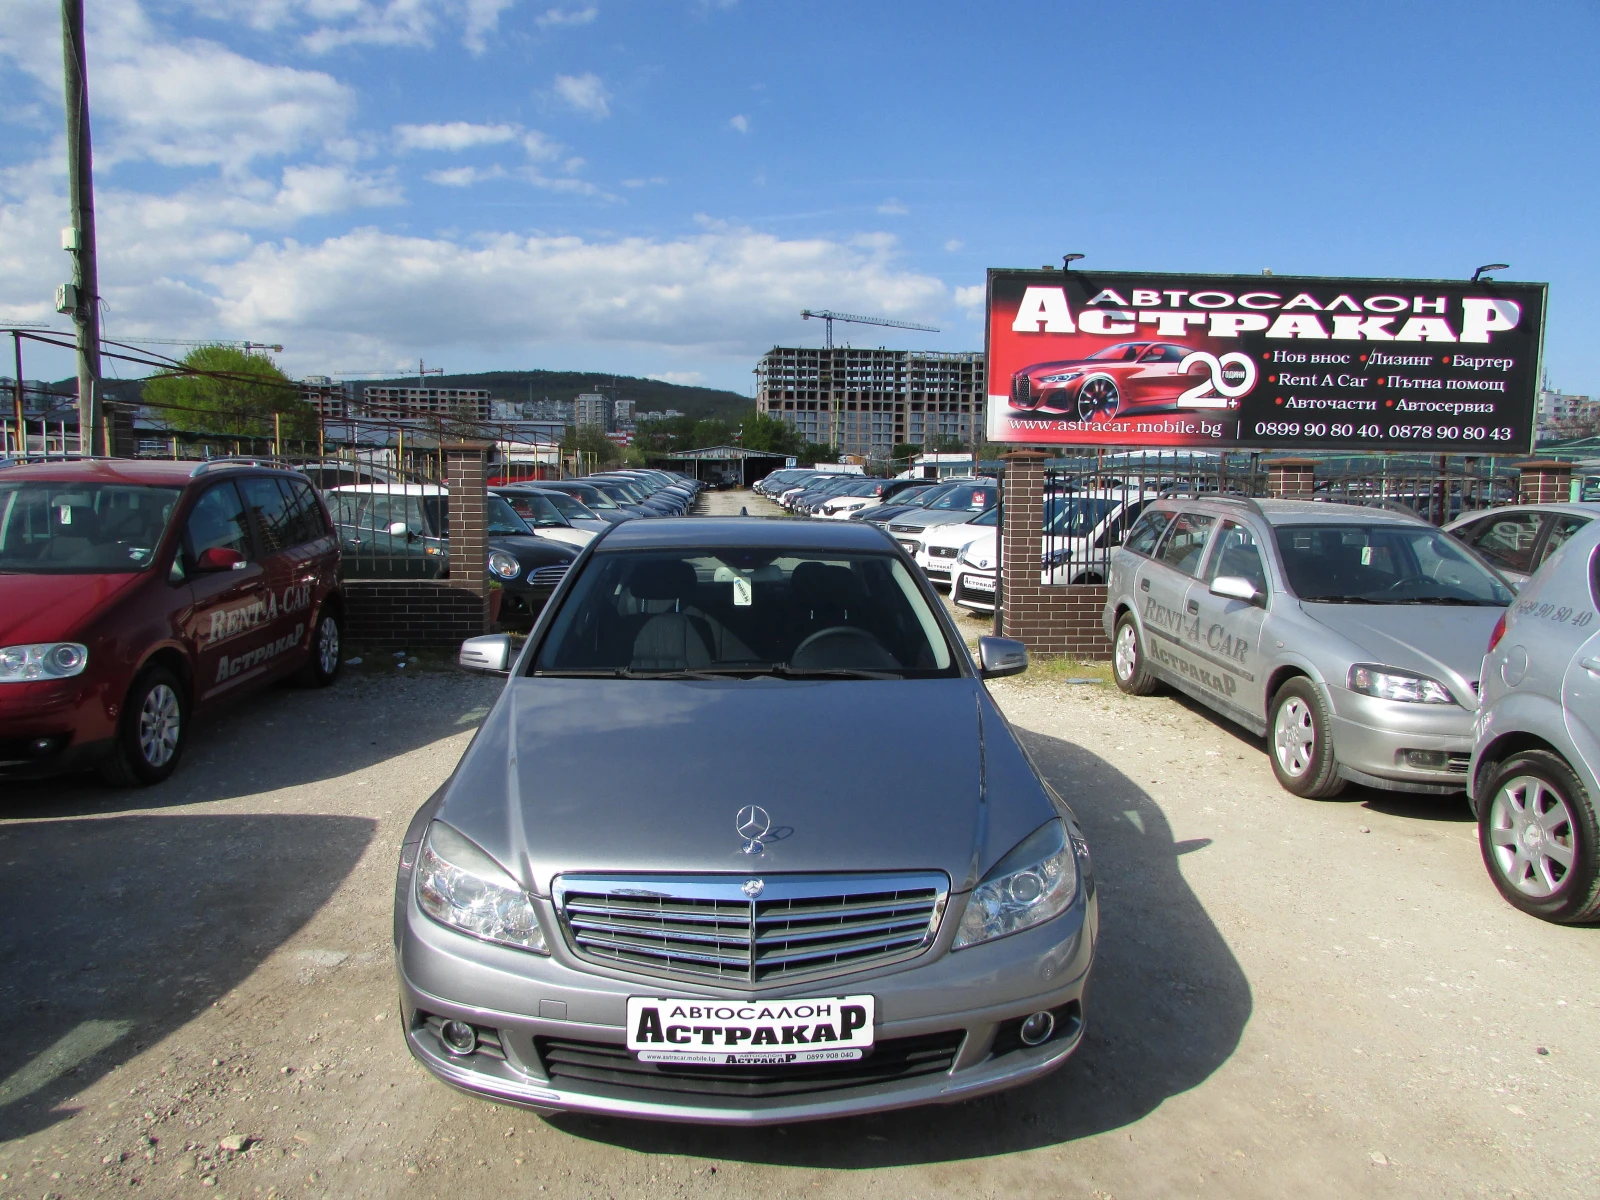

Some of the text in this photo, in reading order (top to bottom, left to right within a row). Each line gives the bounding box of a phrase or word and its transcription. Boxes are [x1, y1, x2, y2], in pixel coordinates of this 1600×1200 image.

[1086, 288, 1447, 314] АВТОСАЛОН
[1273, 351, 1513, 370] Нов внос Лизинг Бартер
[1221, 370, 1246, 380] ГОДИНИ
[1278, 374, 1506, 393] Rent A Car Пътна помощ
[1284, 397, 1494, 415] Авточасти Автосервиз
[1009, 419, 1222, 437] www.astracar.mobile.bg
[1255, 422, 1300, 436] 0899
[1304, 423, 1326, 437] 90
[1330, 424, 1353, 437] 80
[1389, 424, 1432, 439] 0878
[1437, 425, 1459, 439] 90
[1462, 426, 1485, 440] 80
[1489, 427, 1512, 440] 43
[1534, 603, 1555, 619] 90
[1551, 606, 1573, 623] 80
[1571, 610, 1593, 627] 40
[670, 1005, 831, 1020] АВТОСАЛОН
